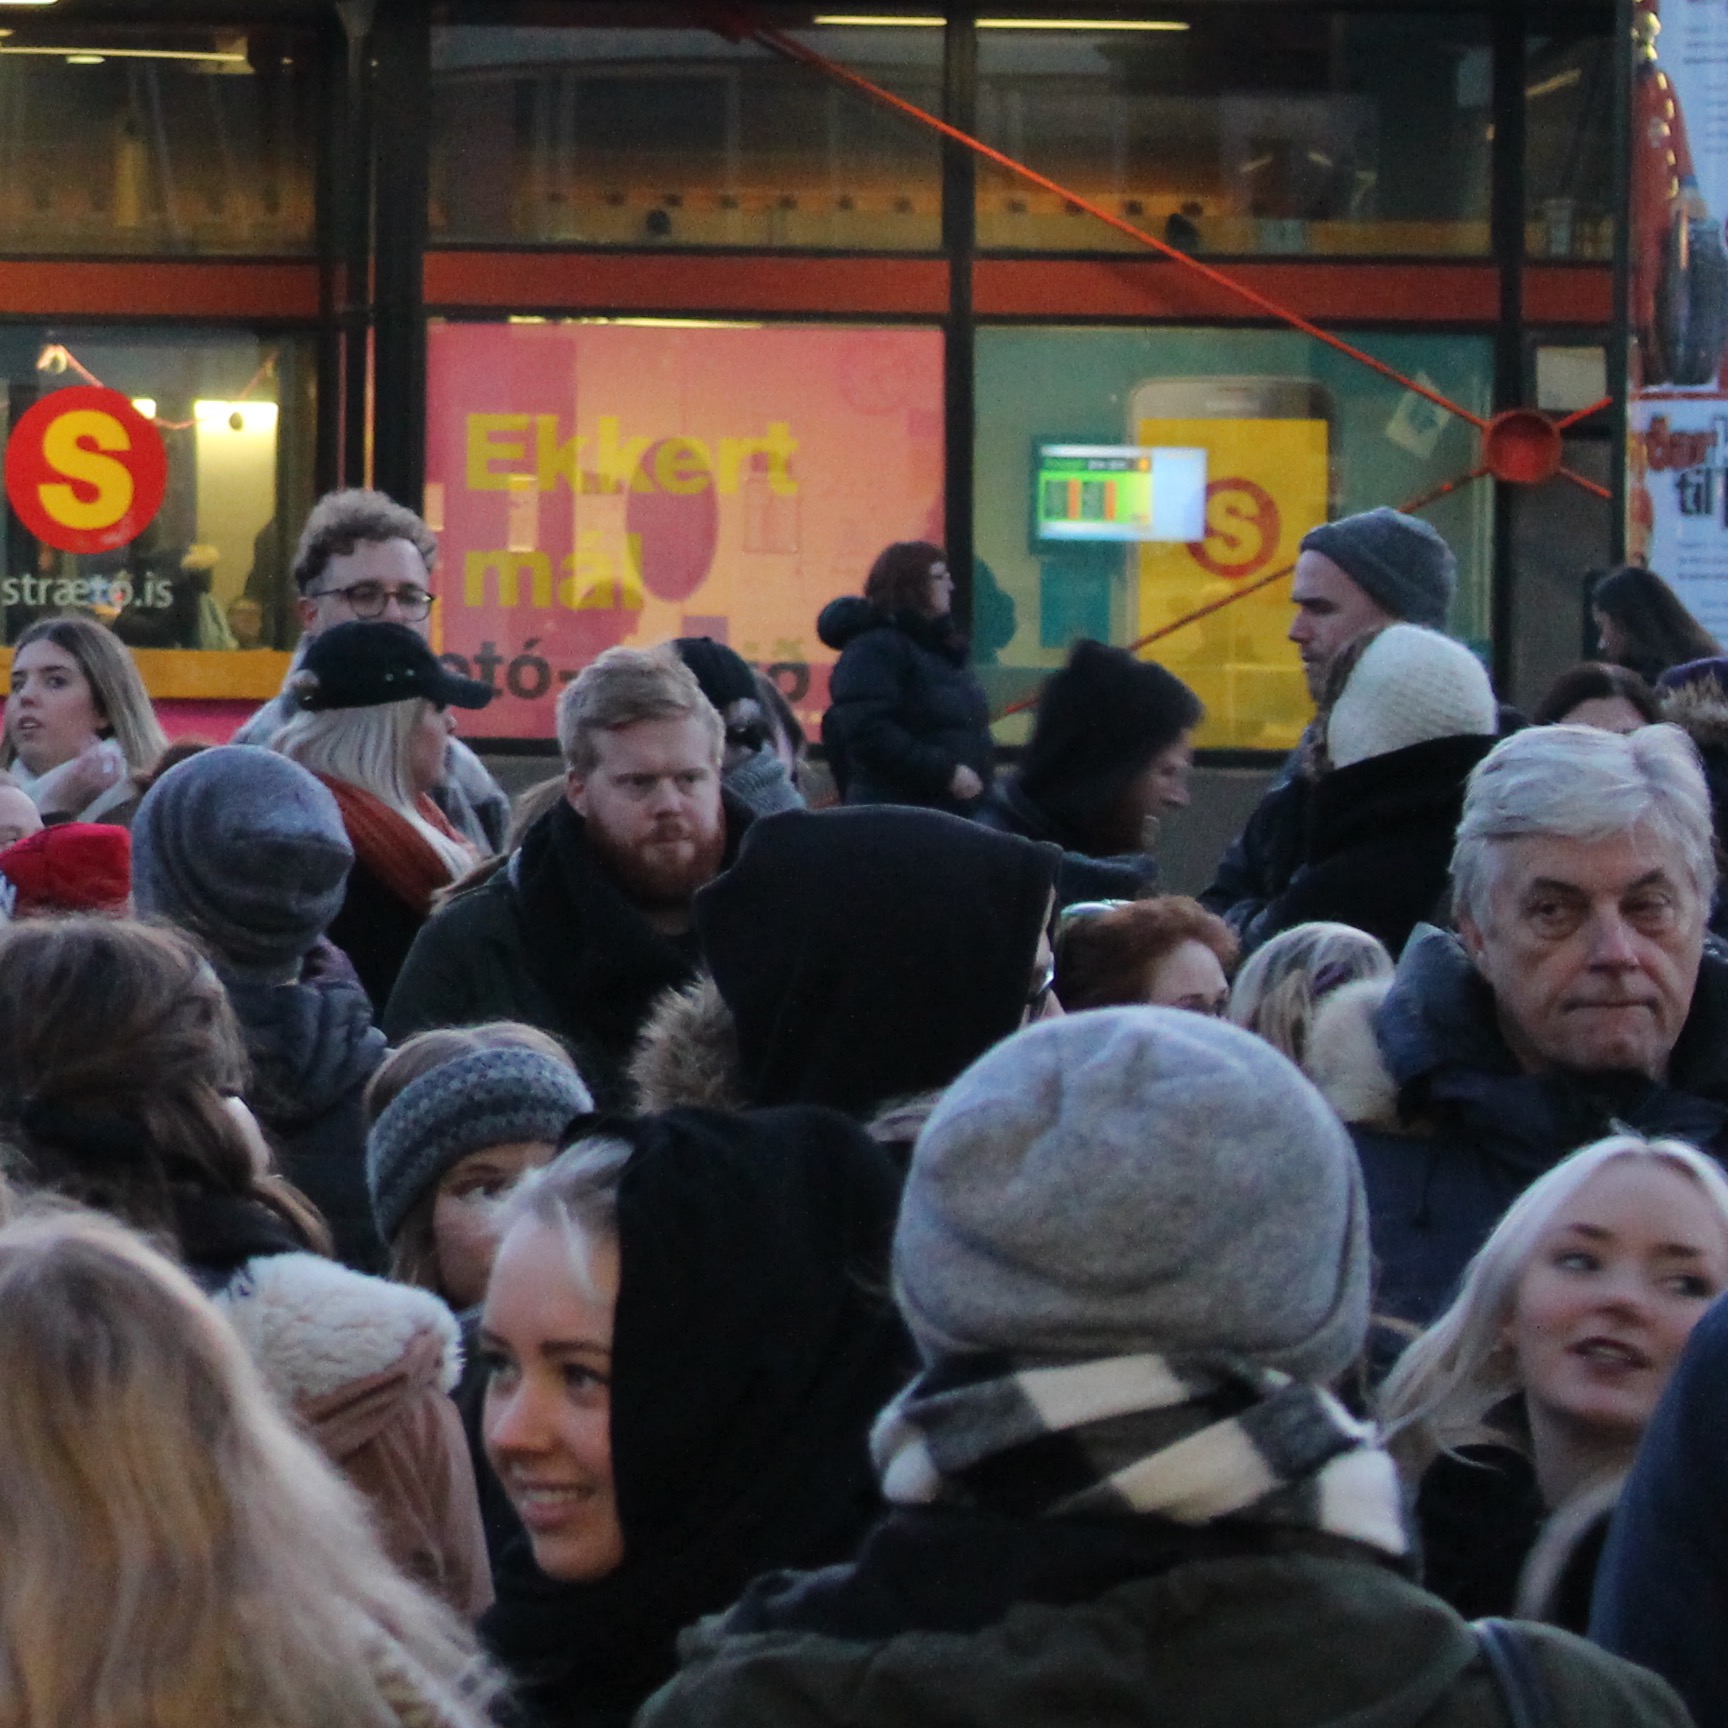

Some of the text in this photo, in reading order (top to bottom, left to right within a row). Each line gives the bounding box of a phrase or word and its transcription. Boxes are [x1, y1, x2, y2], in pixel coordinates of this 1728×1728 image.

[466, 413, 799, 496] Ekkert
[1, 571, 174, 608] strætó.is
[464, 531, 644, 610] mál
